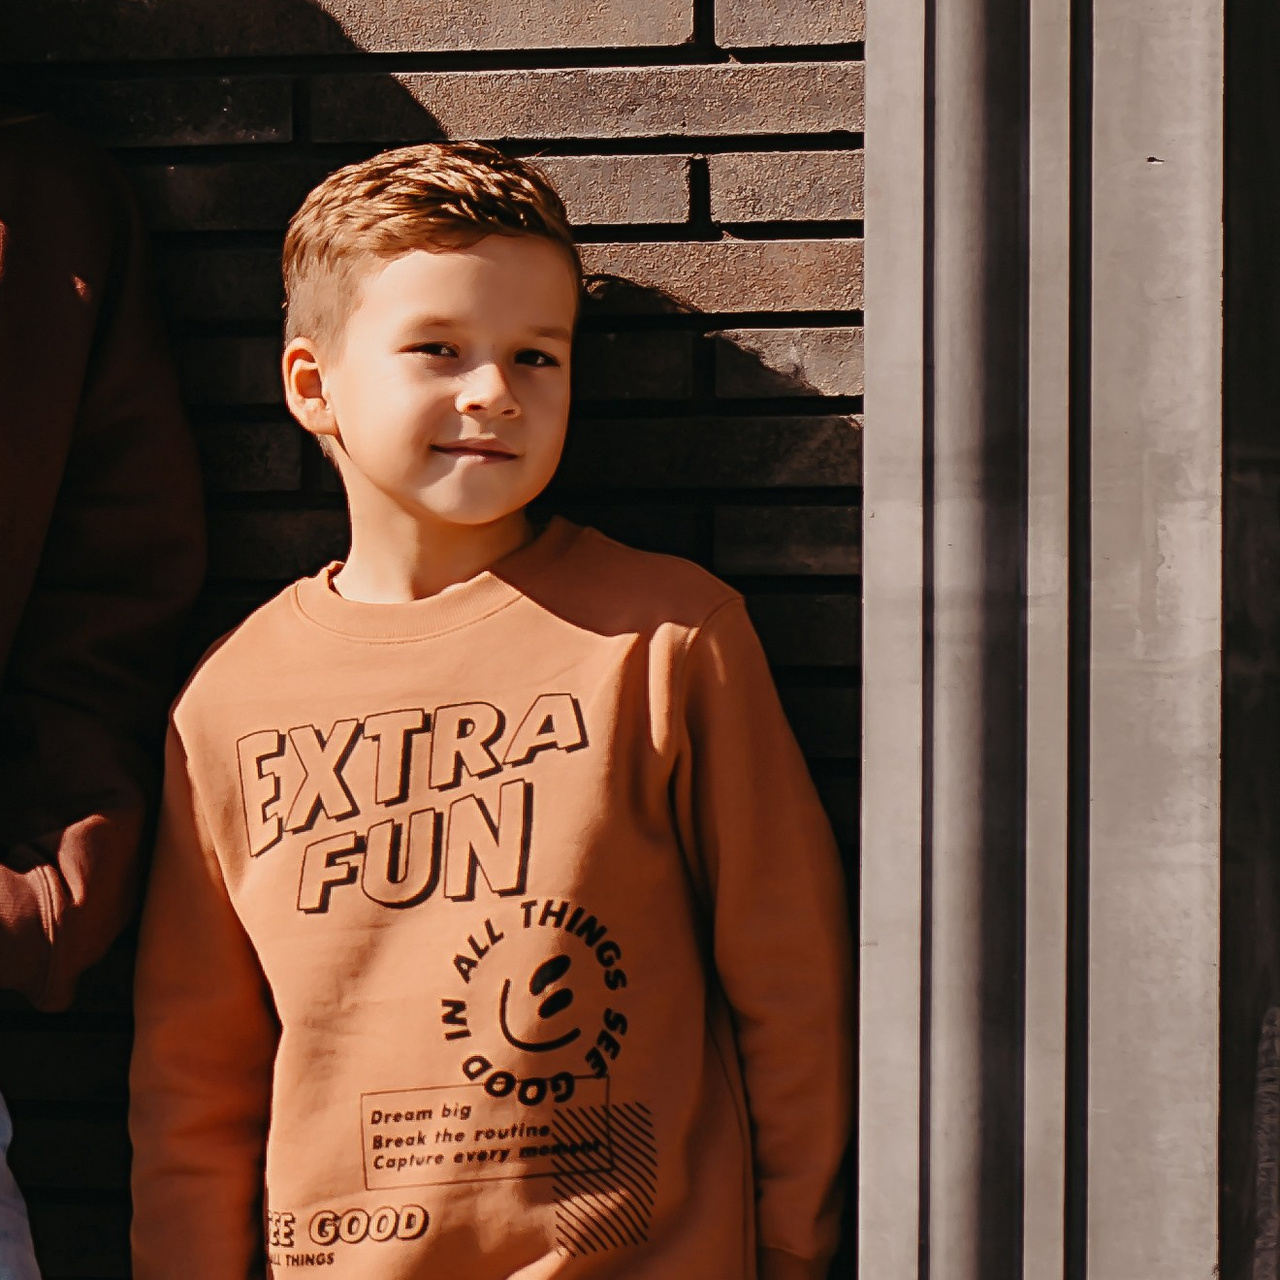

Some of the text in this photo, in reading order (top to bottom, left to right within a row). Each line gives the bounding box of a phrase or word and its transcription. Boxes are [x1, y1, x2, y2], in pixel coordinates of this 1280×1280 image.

[236, 693, 589, 858] EXTRA
[297, 778, 534, 914] FUN
[441, 899, 628, 1106] SEE GOOD IN ALL THINGS
[370, 1102, 472, 1125] Dream big
[372, 1123, 551, 1150] Break the routine
[373, 1152, 445, 1171] Capture
[453, 1147, 511, 1164] every
[309, 1204, 430, 1247] GOOD
[285, 1252, 335, 1267] THINGS
